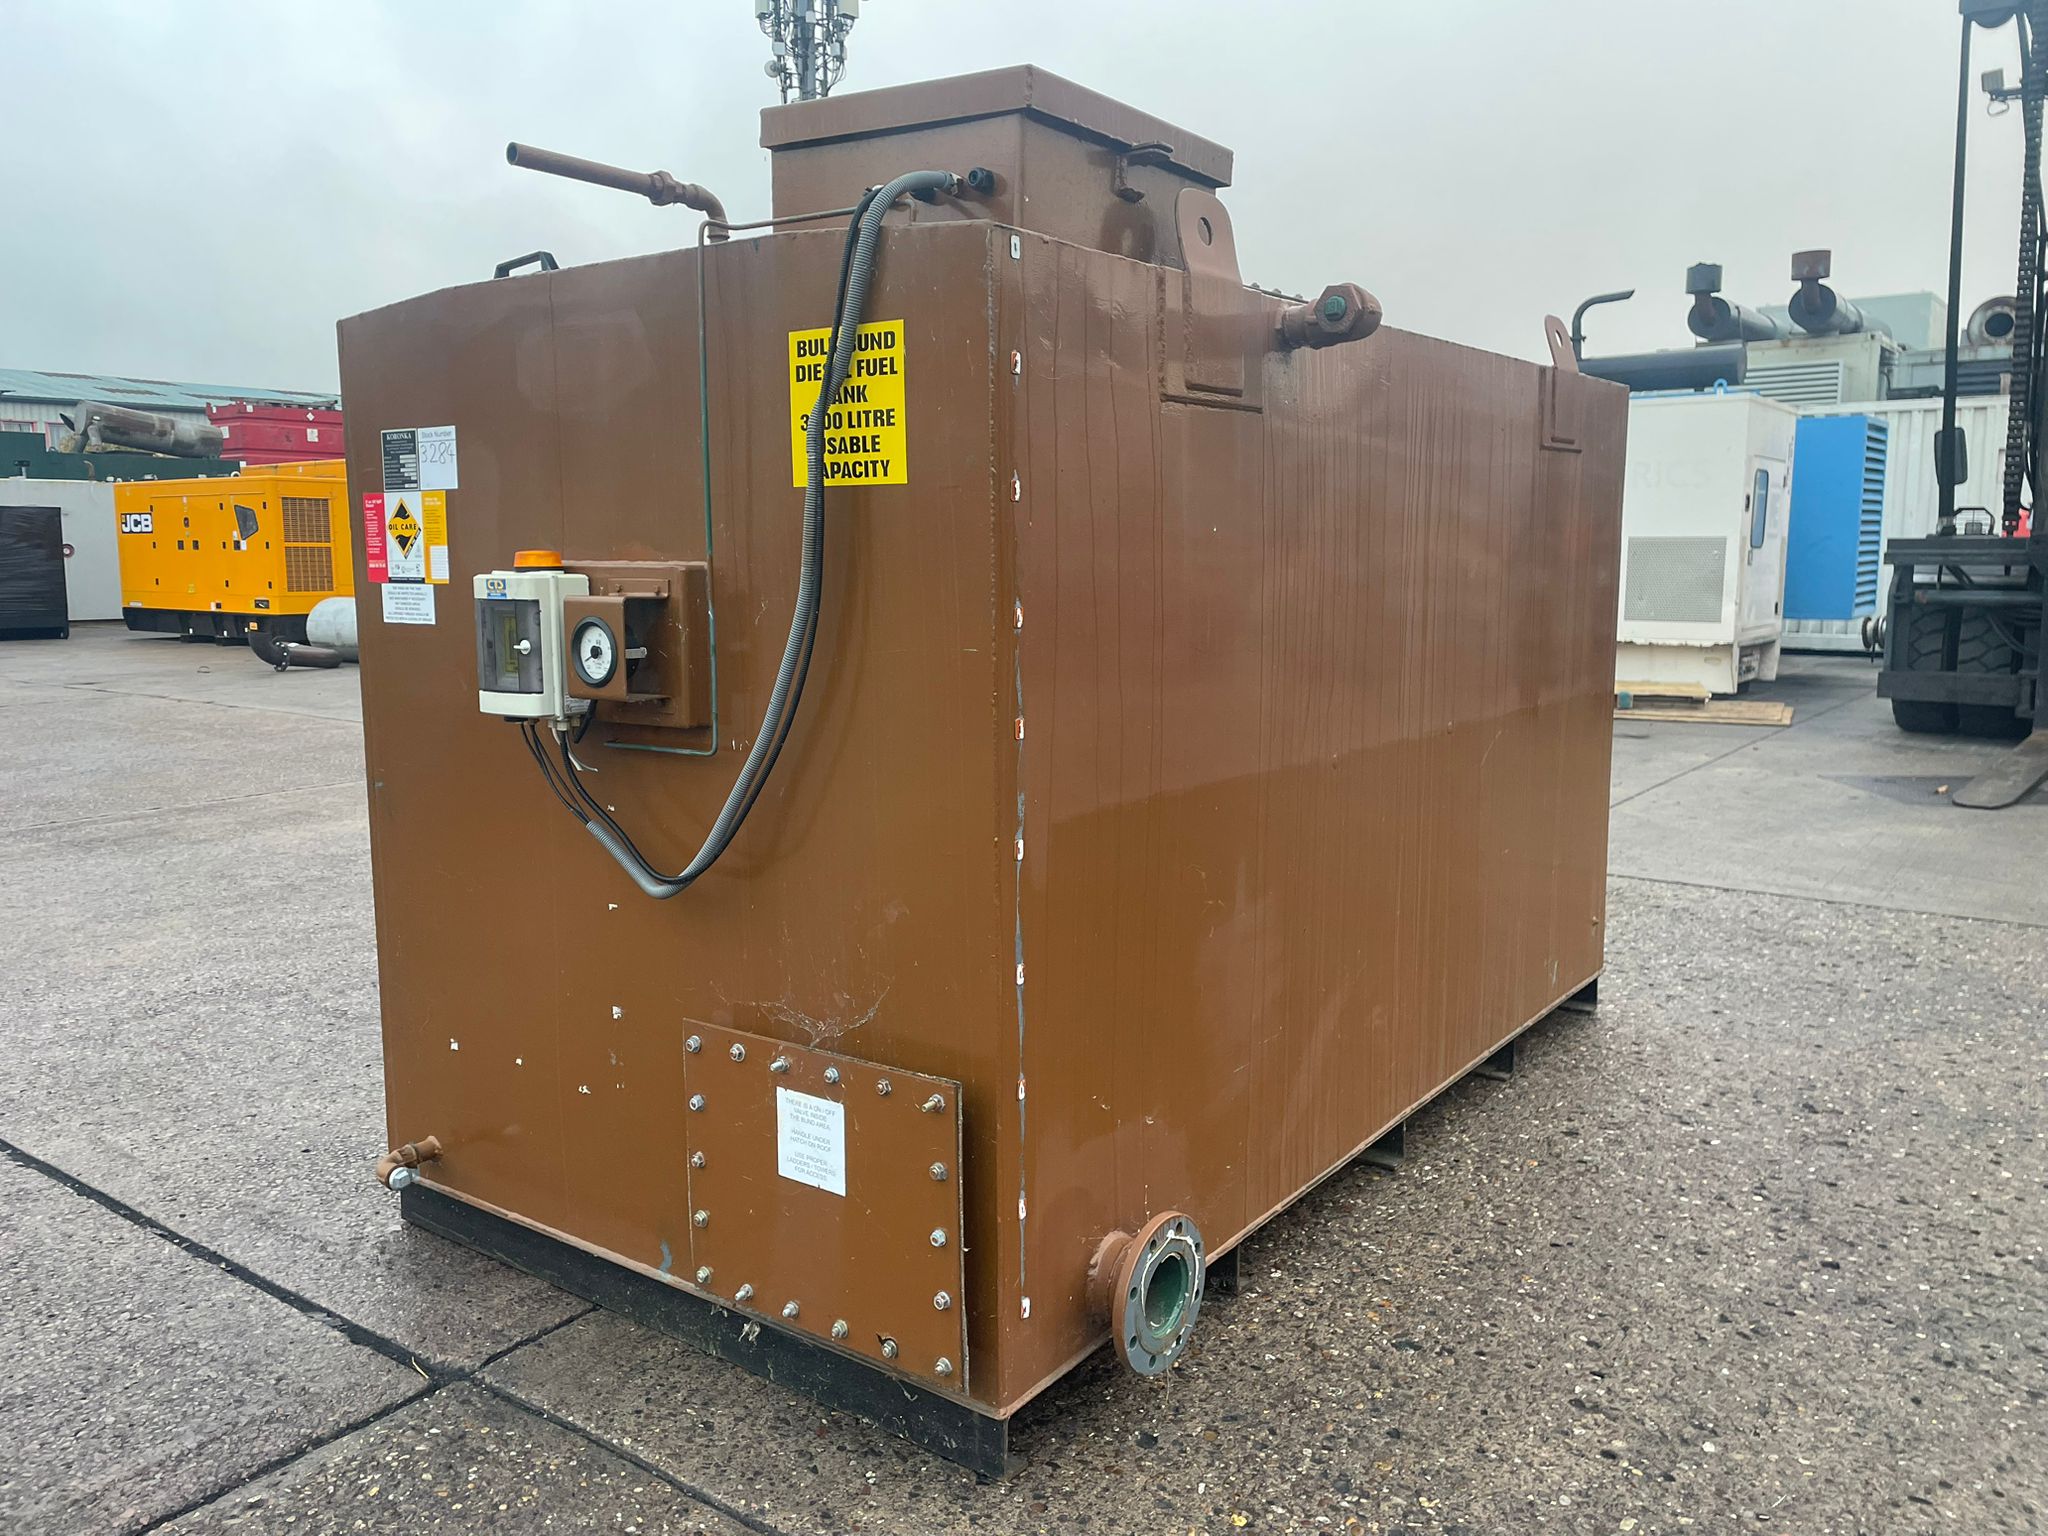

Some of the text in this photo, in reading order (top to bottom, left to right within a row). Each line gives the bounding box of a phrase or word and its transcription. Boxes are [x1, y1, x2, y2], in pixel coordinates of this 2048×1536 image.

[797, 330, 896, 358] BUL UND
[856, 356, 898, 377] FUEL
[831, 384, 868, 405] ANK
[800, 408, 896, 431] 300 LITRE
[386, 432, 412, 441] KORONKA
[823, 434, 881, 455] SABLE
[420, 441, 456, 464] 3284
[823, 459, 890, 479] APACITY
[121, 514, 153, 533] JCB
[388, 523, 399, 531] OIL
[793, 1107, 809, 1116] VALVE
[791, 1127, 812, 1139] HANDLE
